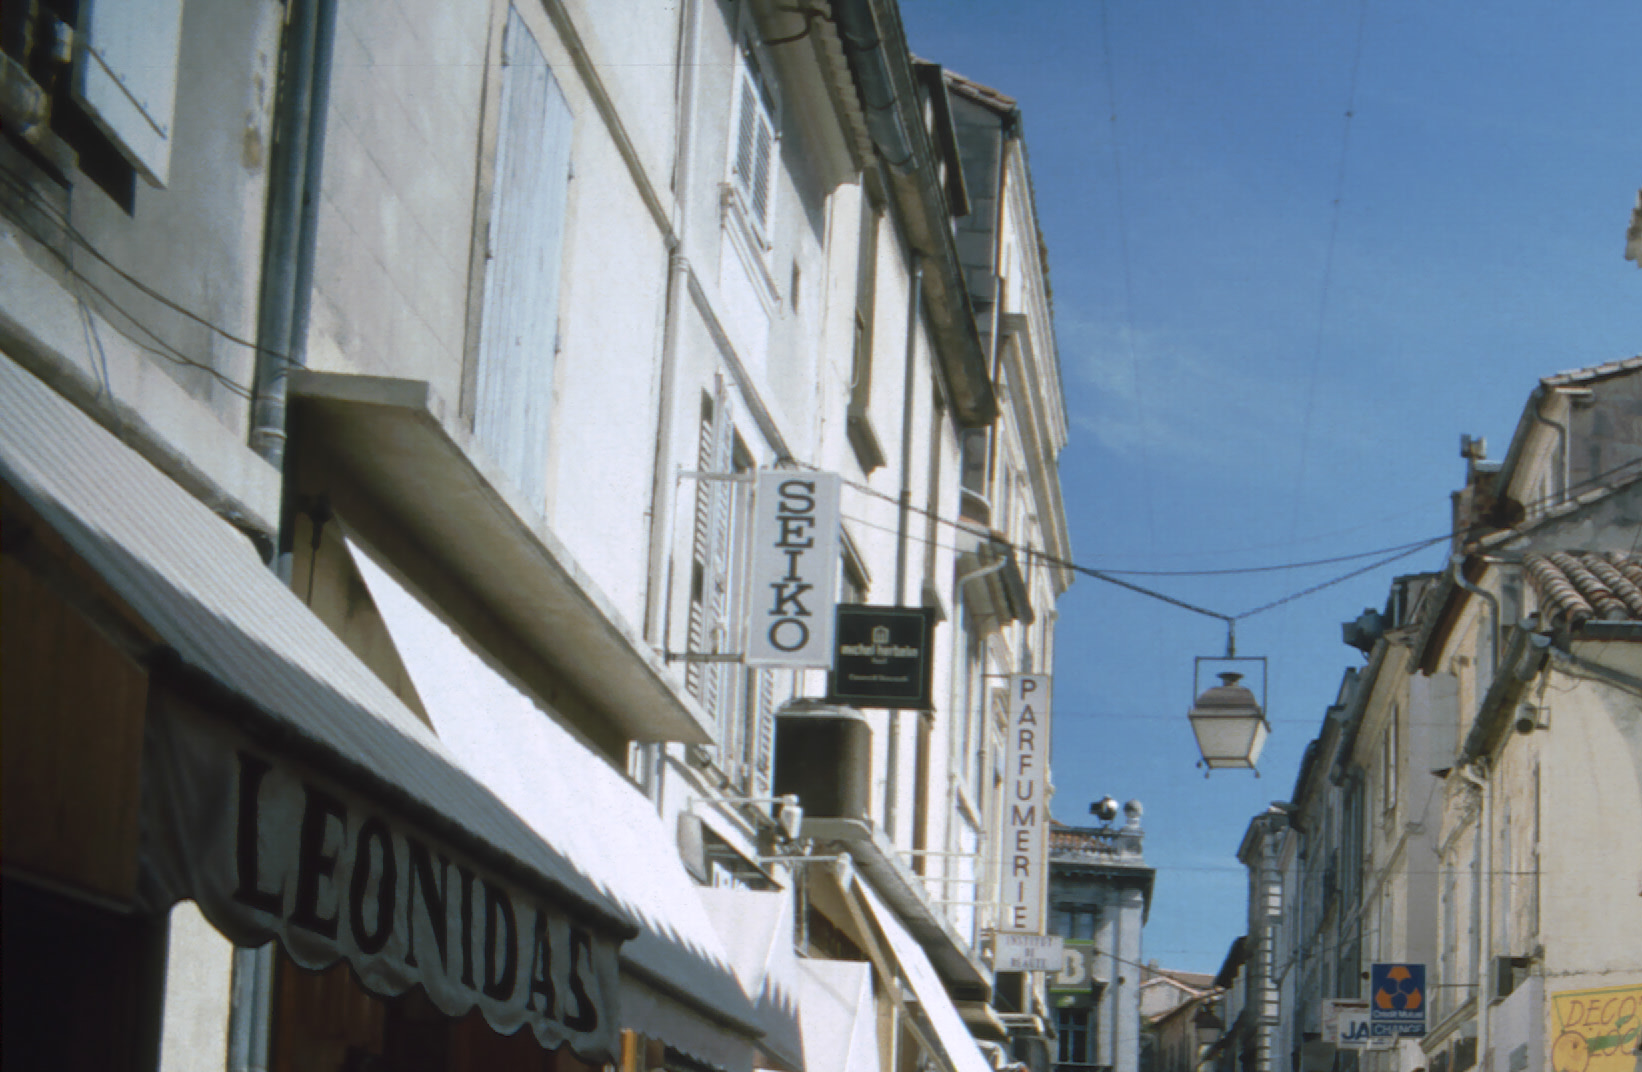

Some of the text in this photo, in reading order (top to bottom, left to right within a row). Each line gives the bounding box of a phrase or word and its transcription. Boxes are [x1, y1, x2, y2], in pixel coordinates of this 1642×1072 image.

[768, 480, 816, 653] SEIKO
[232, 749, 599, 1033] LEONIDAS
[1011, 679, 1037, 928] PARFUMERIE
